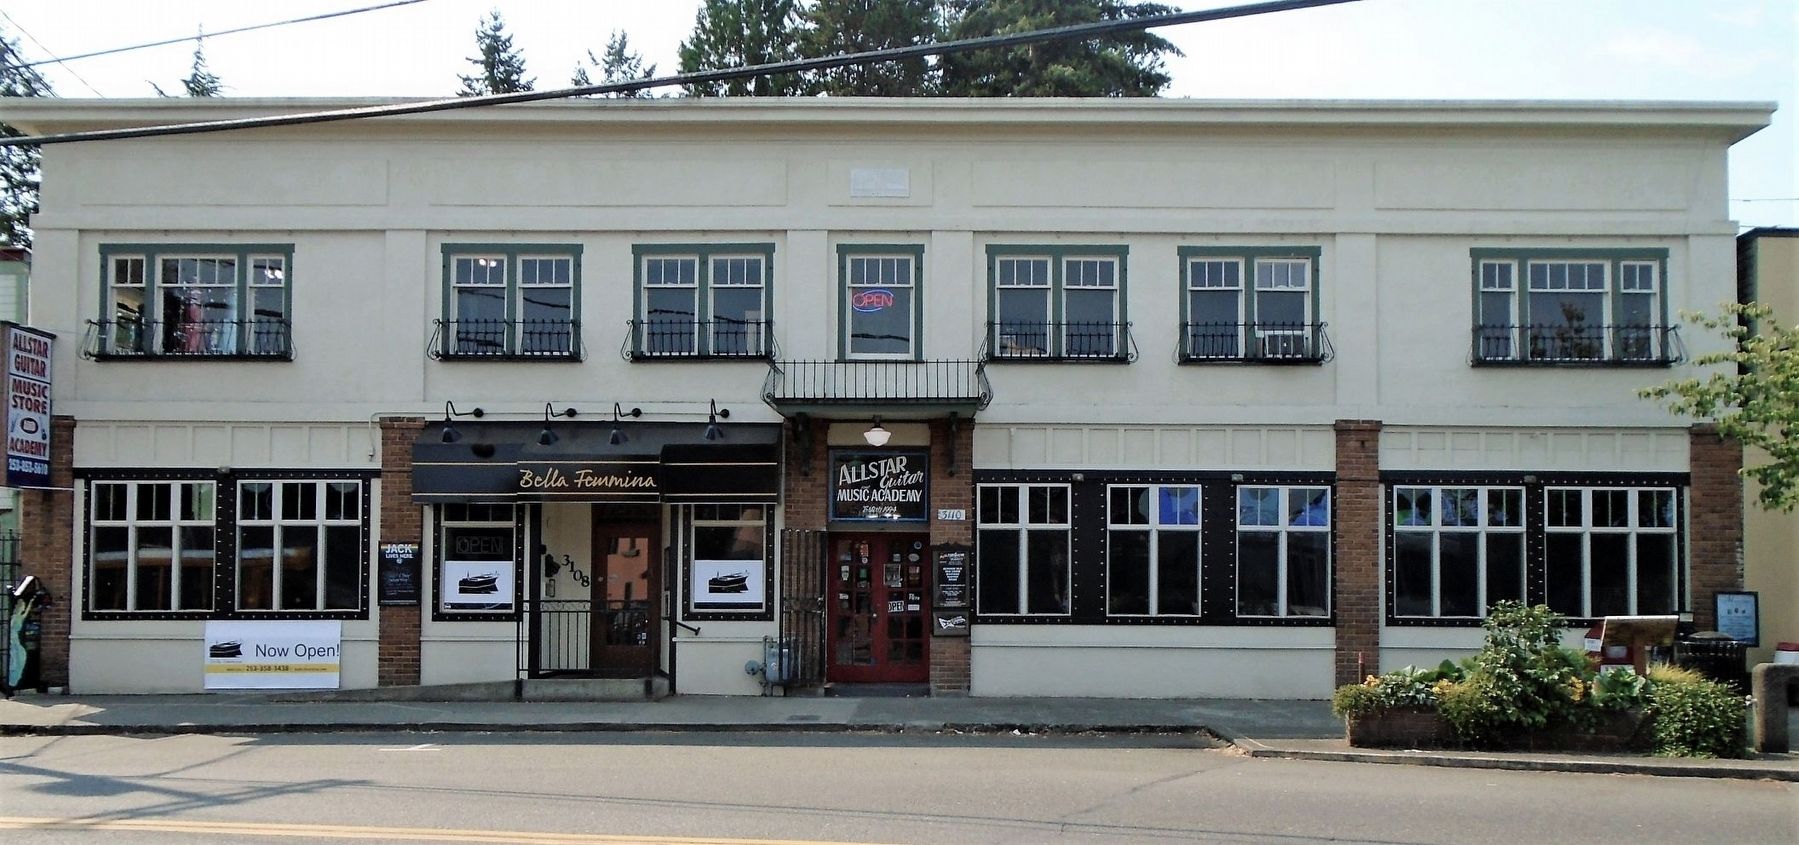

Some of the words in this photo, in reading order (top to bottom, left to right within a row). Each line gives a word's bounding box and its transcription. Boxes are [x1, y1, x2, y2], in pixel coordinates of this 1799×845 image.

[853, 293, 893, 307] OPEN
[14, 333, 48, 358] ALLSTAR
[15, 354, 46, 377] GUITAR
[12, 379, 47, 399] MUSIC
[12, 395, 47, 414] STORE
[9, 437, 47, 456] ACADEMY
[520, 467, 569, 488] Bella
[574, 470, 657, 488] Femmina
[839, 455, 907, 486] ALLSTAR
[879, 470, 924, 495] Guitar
[837, 488, 870, 502] MUSIC
[870, 488, 923, 503] ACADEMY
[940, 510, 962, 519] 3110
[385, 543, 413, 554] JACK
[455, 536, 504, 554] OPEN
[561, 554, 590, 588] 3108
[255, 643, 290, 658] Now
[294, 643, 340, 661] Open!
